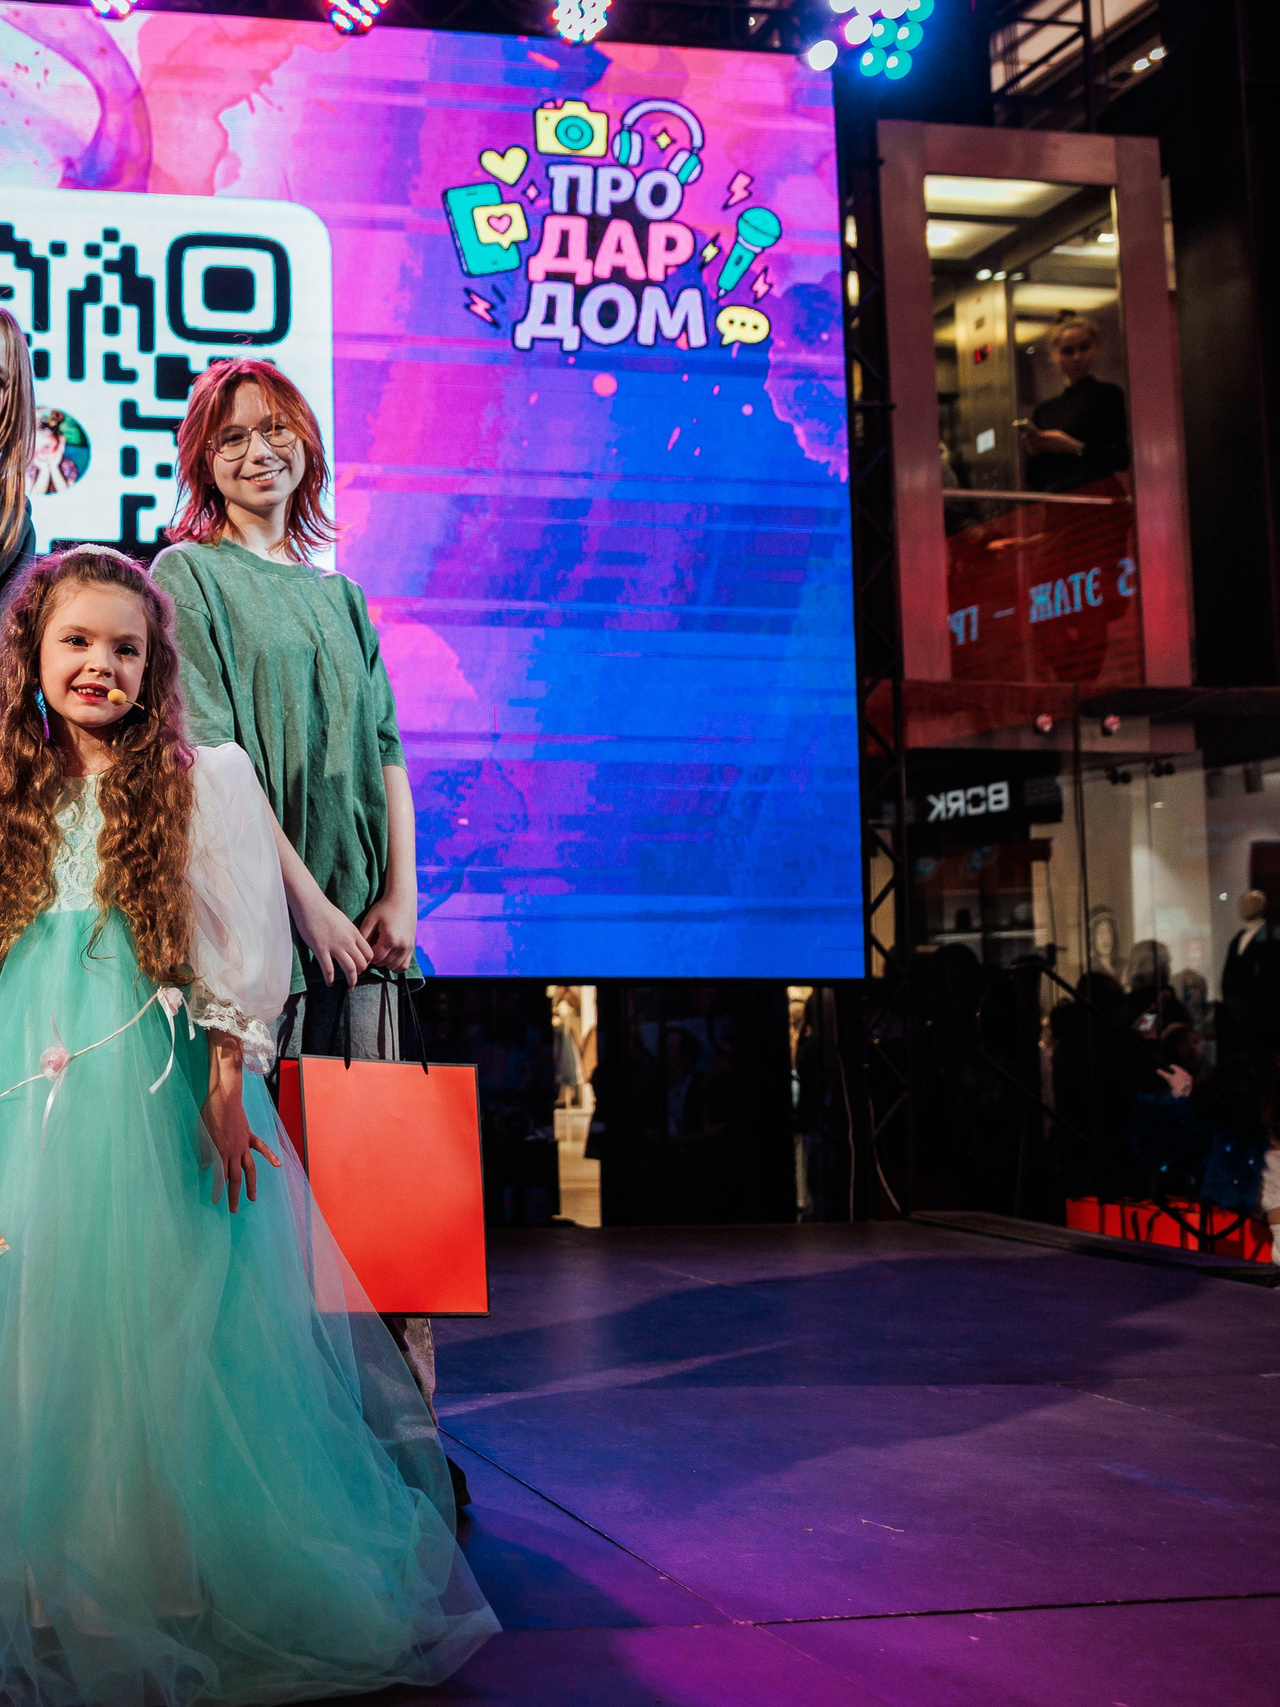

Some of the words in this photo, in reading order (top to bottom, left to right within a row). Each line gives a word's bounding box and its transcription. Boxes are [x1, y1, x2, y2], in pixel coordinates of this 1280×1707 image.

[548, 164, 683, 221] ПРО
[527, 214, 696, 286] ДАР
[514, 281, 707, 351] ДОМ
